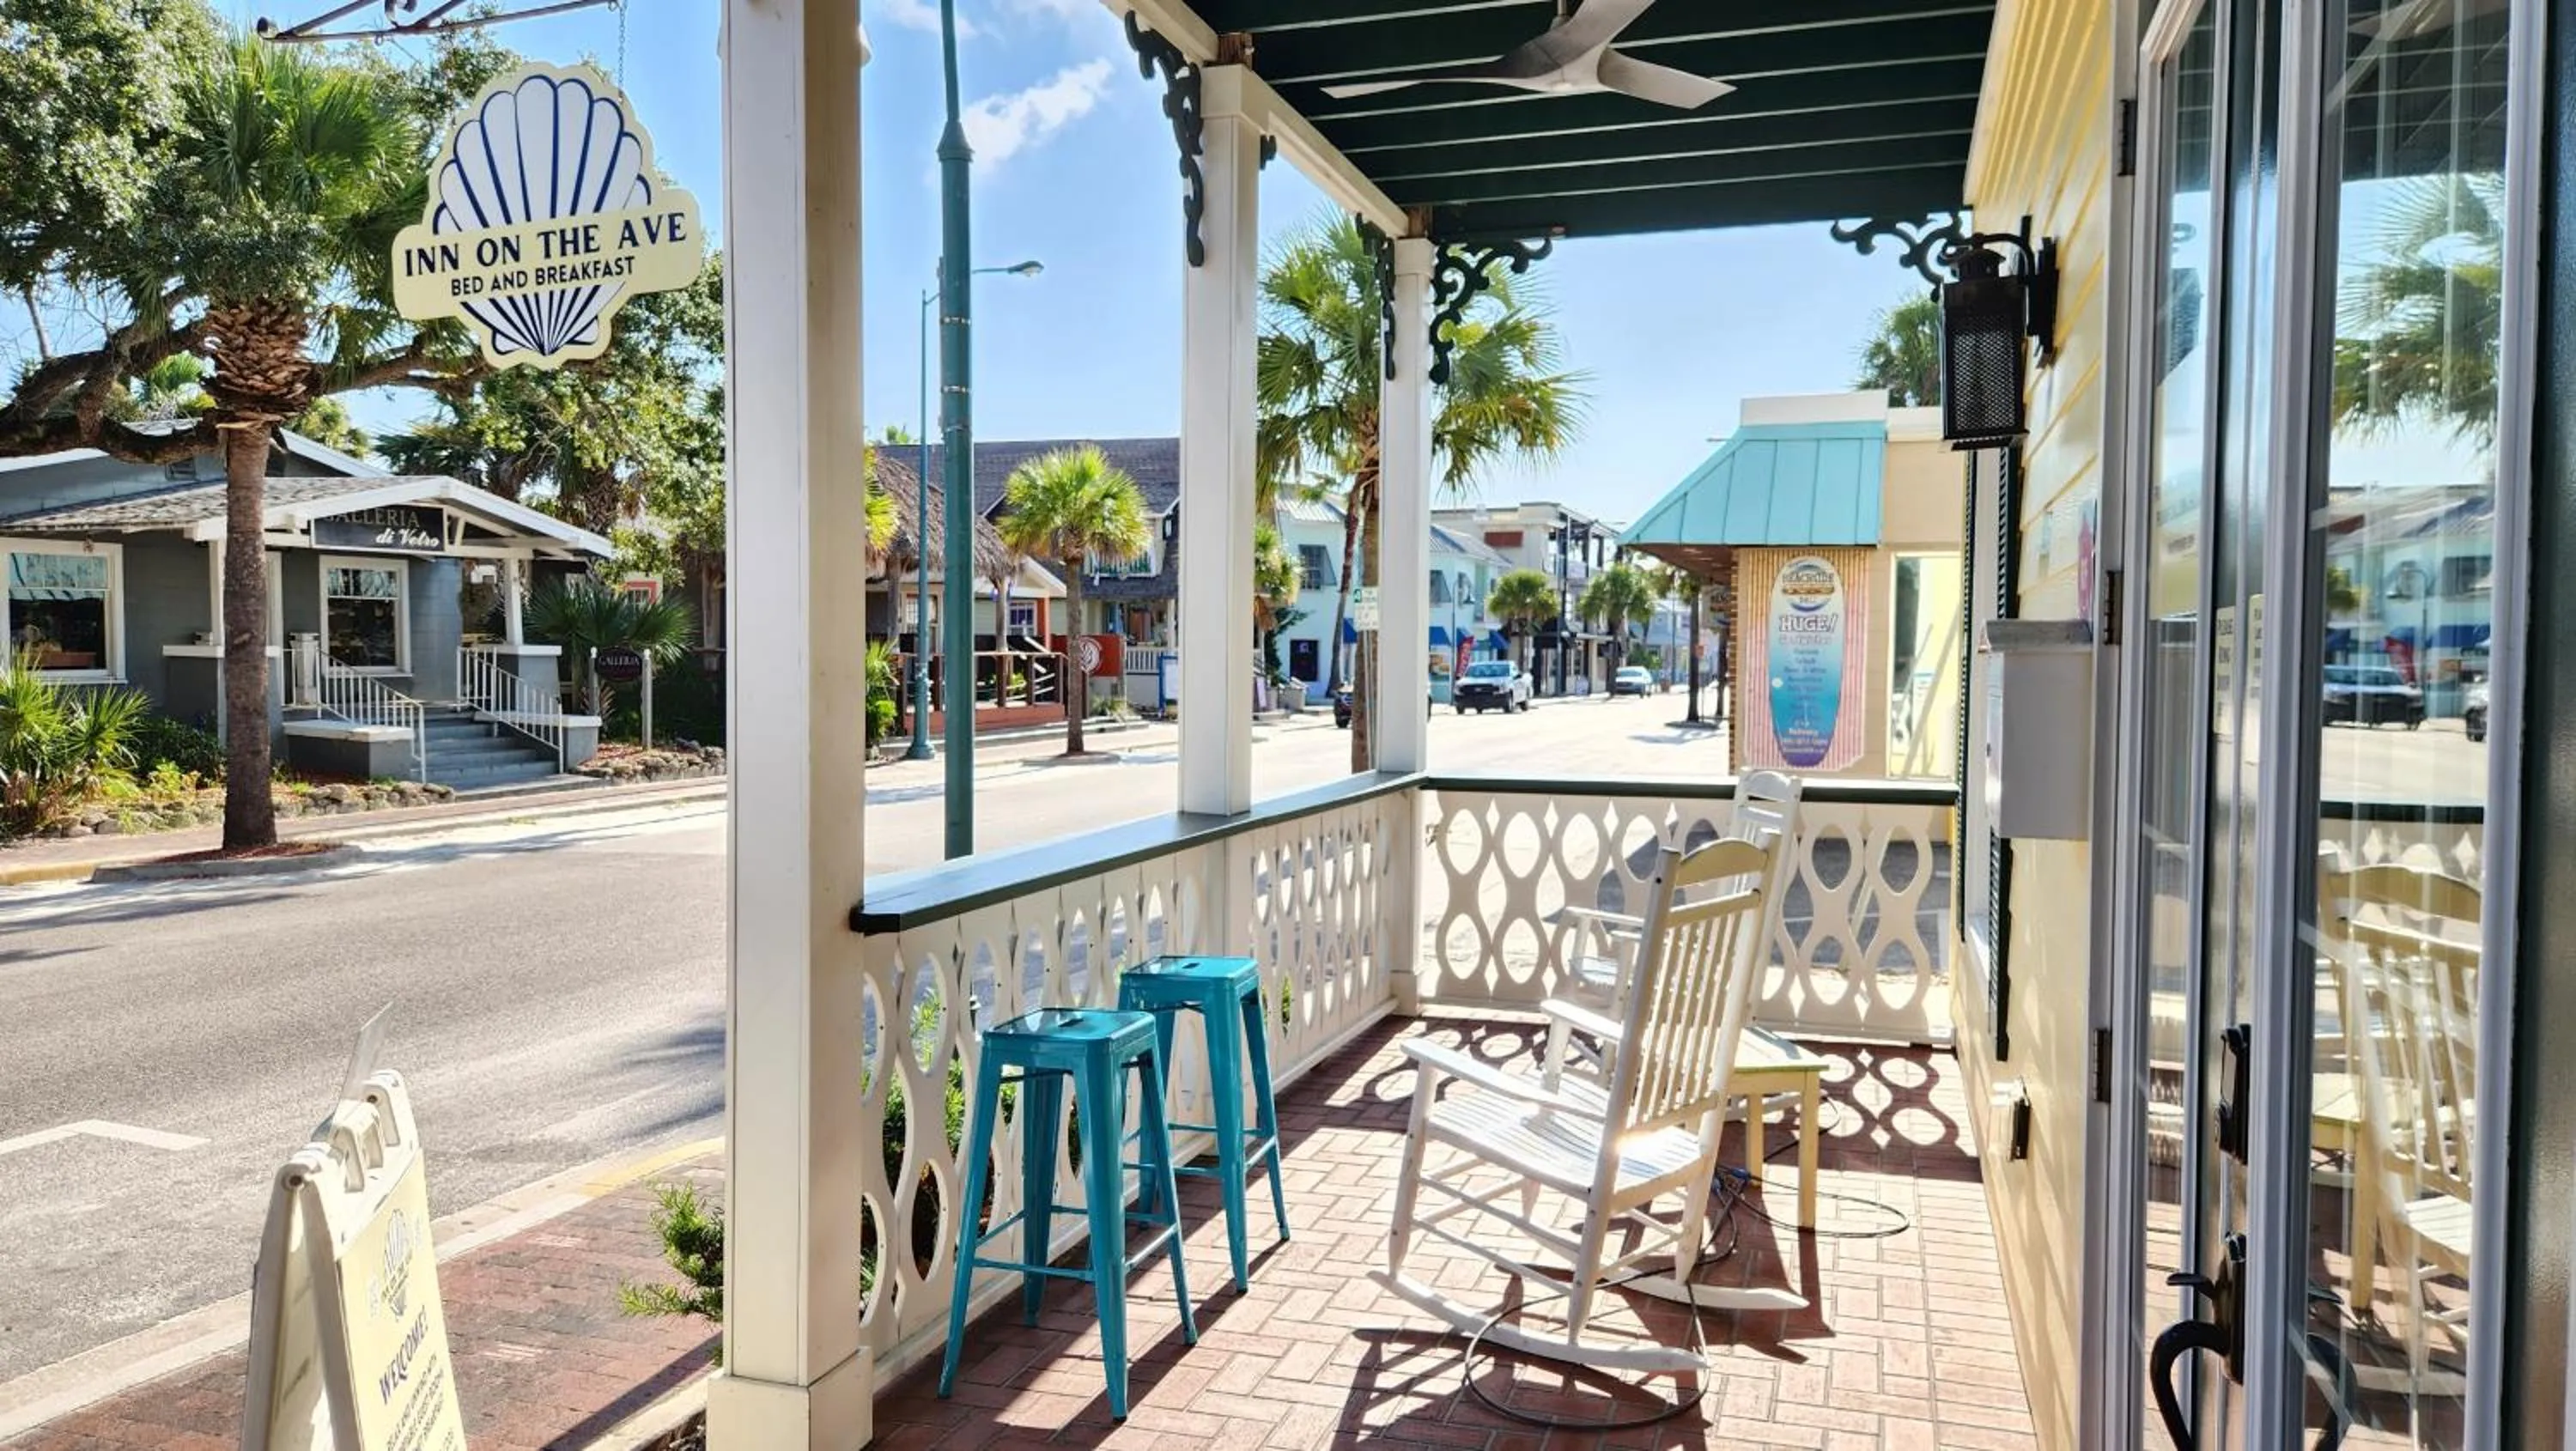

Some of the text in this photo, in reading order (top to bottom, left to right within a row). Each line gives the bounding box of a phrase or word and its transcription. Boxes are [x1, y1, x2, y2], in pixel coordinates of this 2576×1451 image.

[405, 212, 688, 277] INN ON THE AVE
[451, 256, 635, 296] BED AND BREAKFAST
[375, 527, 396, 544] di
[1779, 613, 1838, 633] HUGE!
[598, 655, 640, 666] GALLERIA
[380, 1304, 429, 1405] WELCOME!
